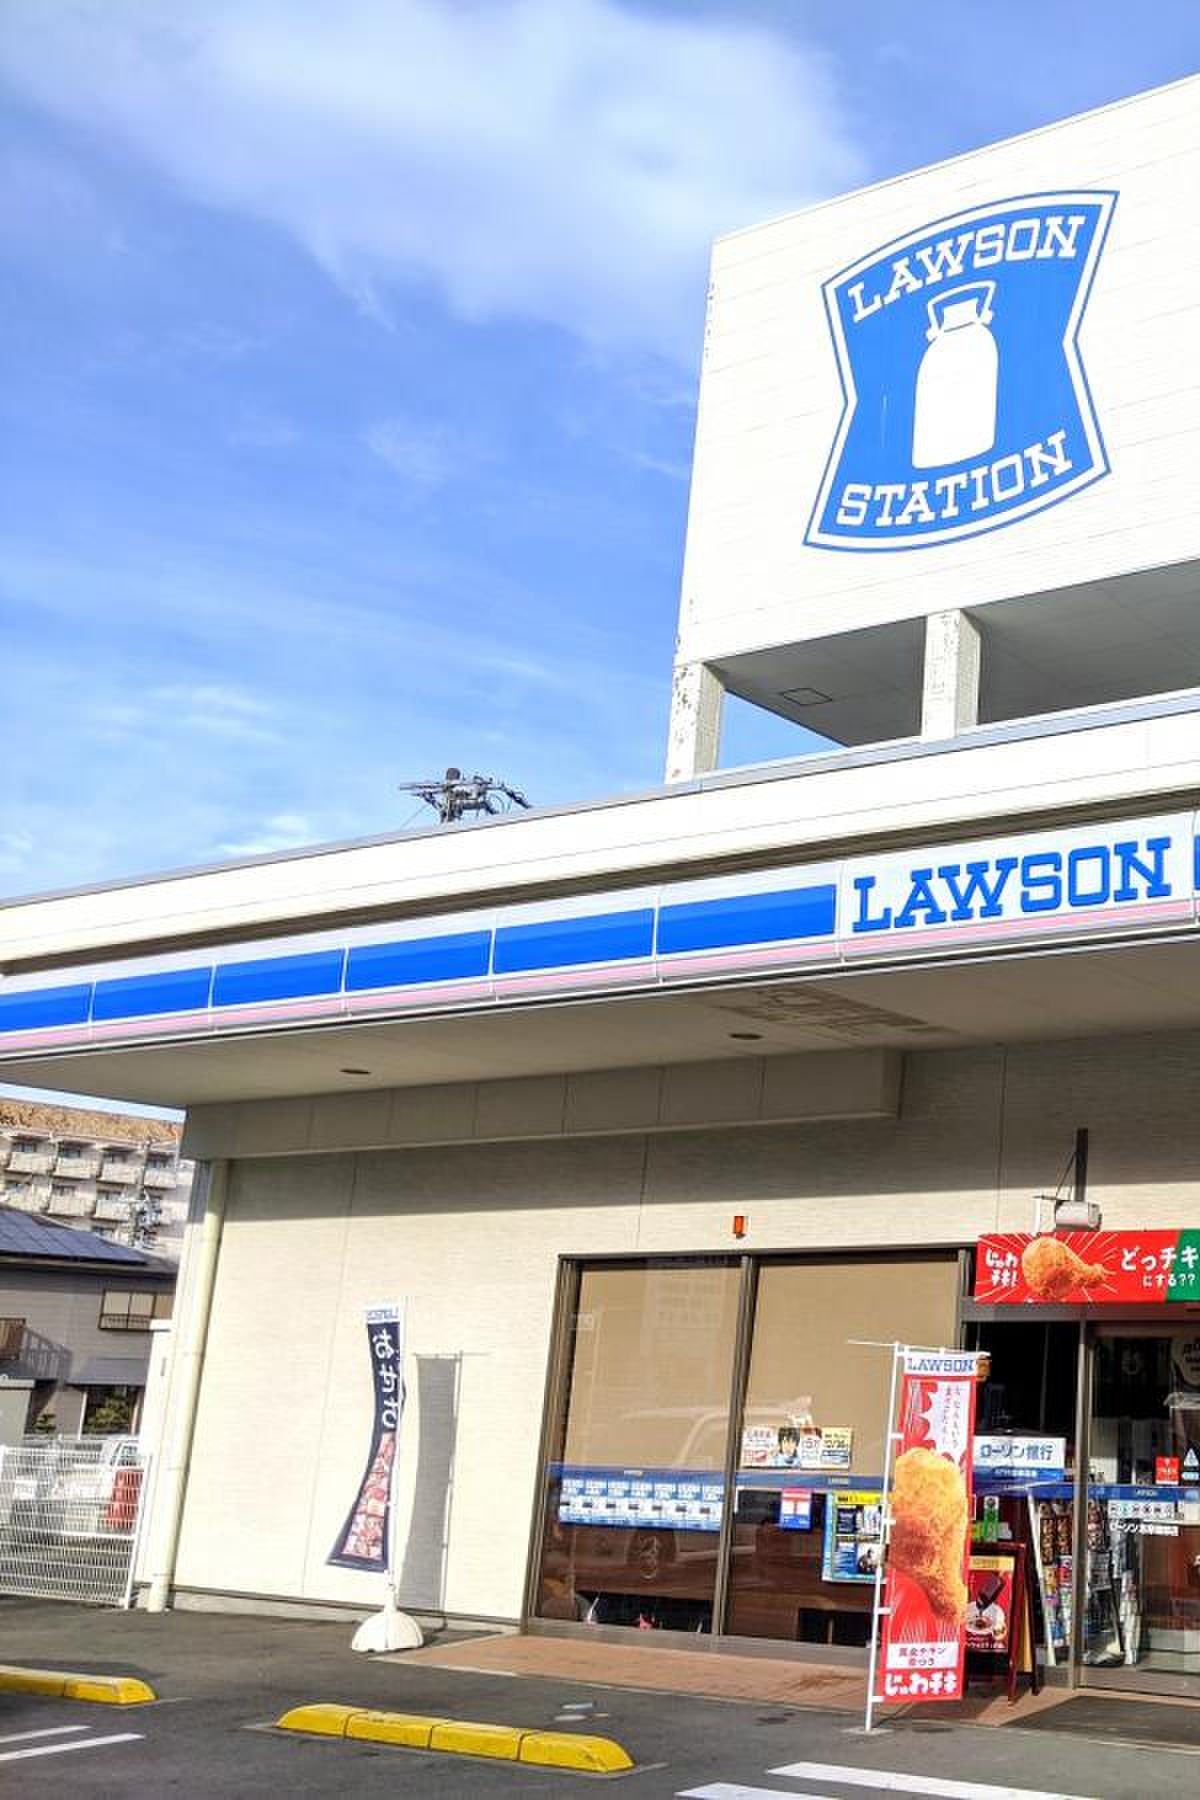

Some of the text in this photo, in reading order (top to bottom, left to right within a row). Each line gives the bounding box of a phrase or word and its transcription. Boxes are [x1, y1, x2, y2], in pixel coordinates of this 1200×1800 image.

[848, 216, 1085, 322] LAWSON
[836, 429, 1073, 527] STATION
[852, 836, 1171, 933] LAWSON
[1143, 1273, 1196, 1287] にする??
[907, 1358, 974, 1372] LAWSON
[980, 1442, 1055, 1461] ローソン銀行
